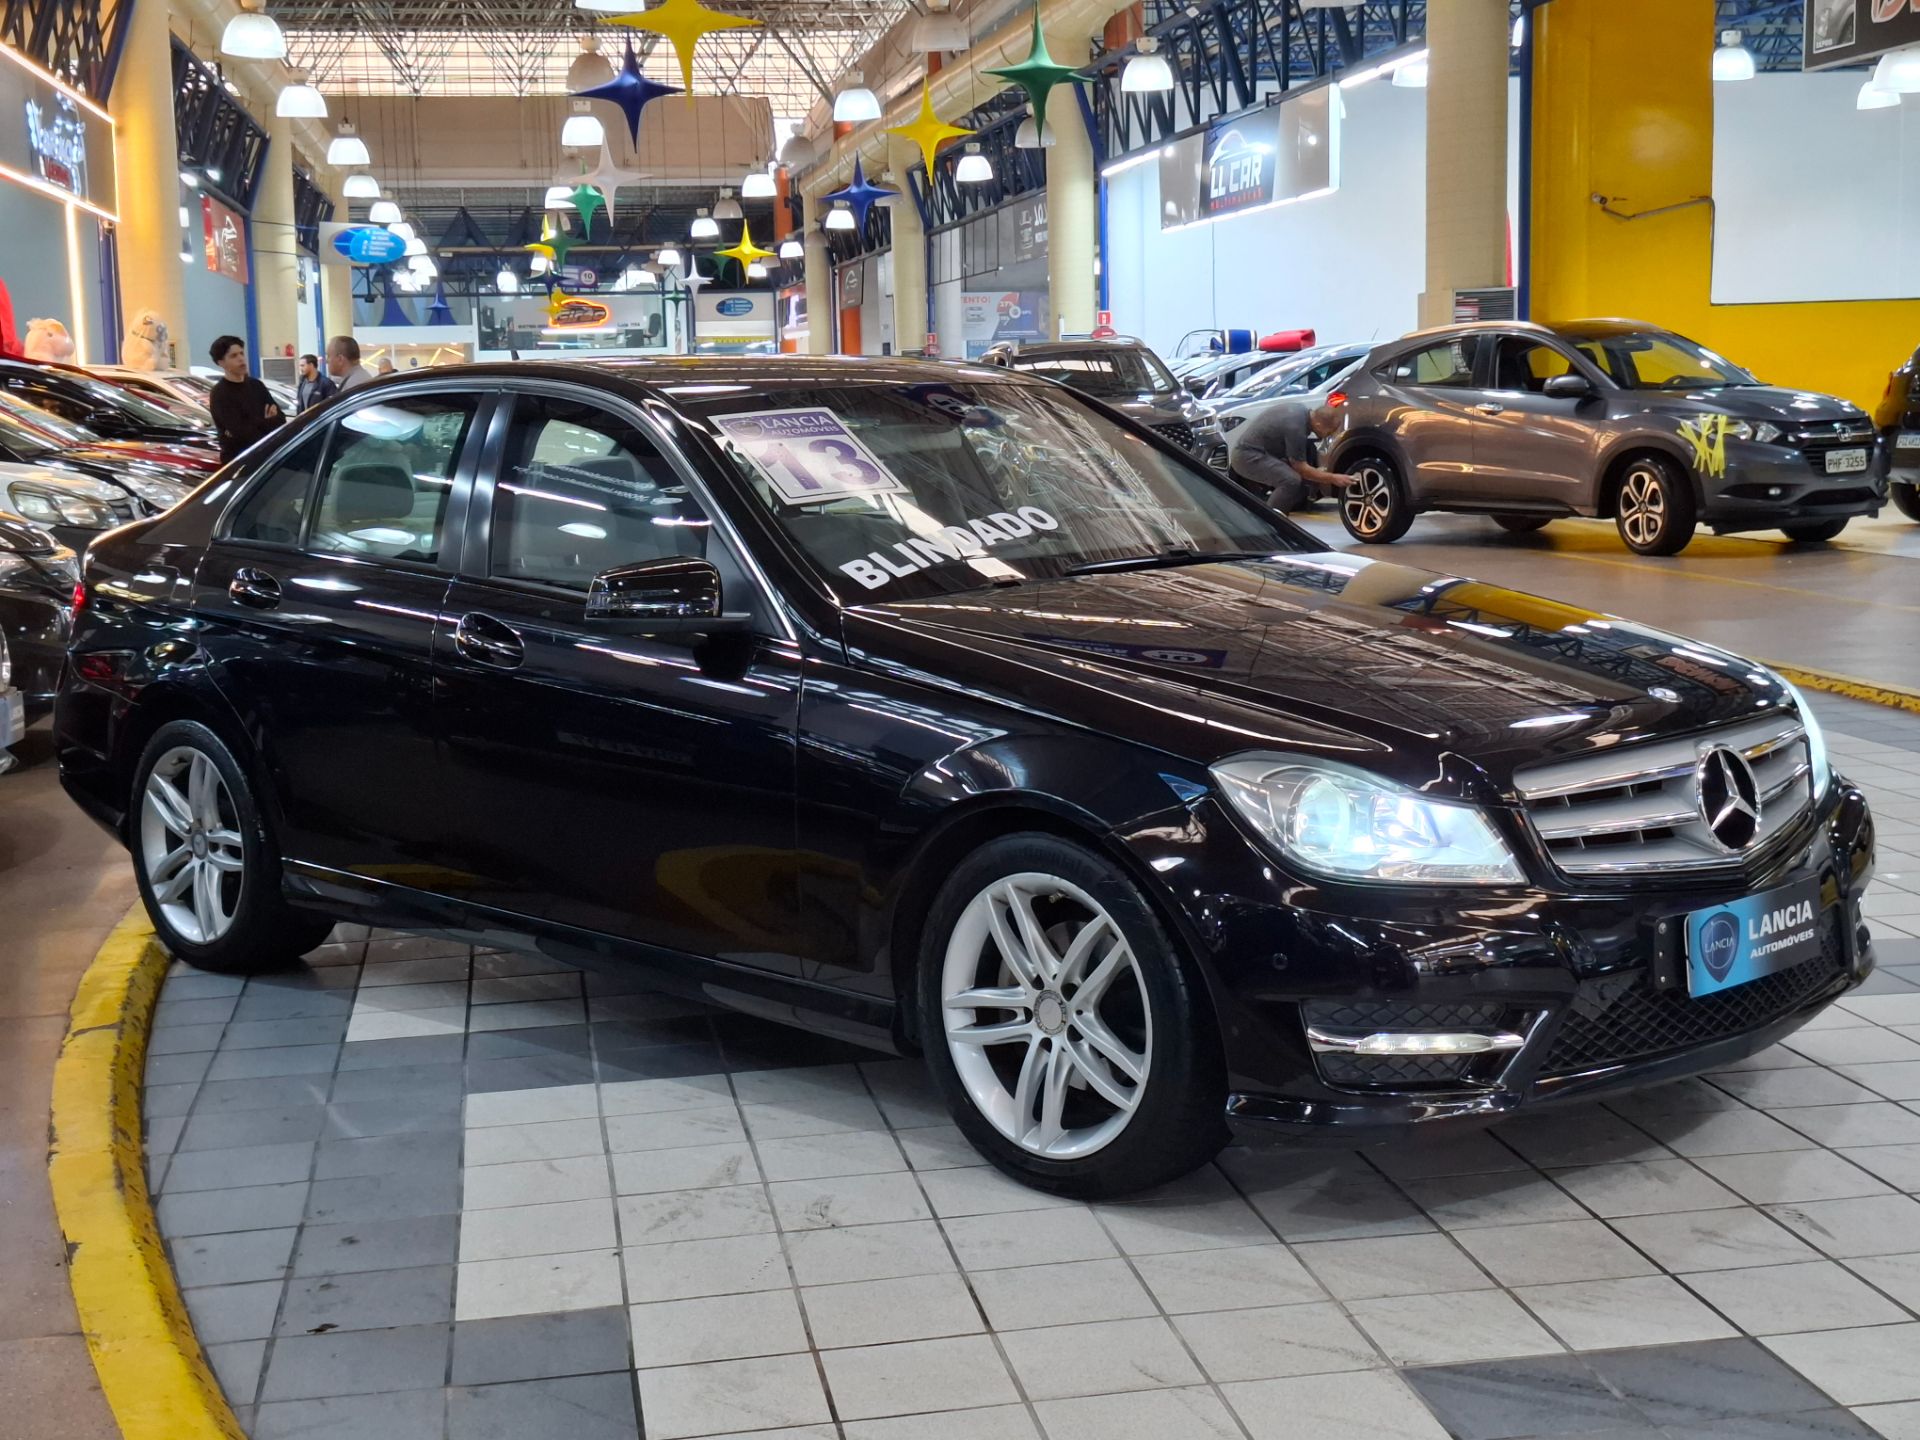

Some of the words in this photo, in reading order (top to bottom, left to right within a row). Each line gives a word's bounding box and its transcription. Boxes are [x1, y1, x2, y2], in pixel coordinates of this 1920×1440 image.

[1210, 165, 1226, 198] LL
[1230, 154, 1263, 192] CAR
[760, 415, 834, 429] LANCIA
[771, 425, 841, 436] AUTOMÓVEIS
[759, 439, 881, 490] 13
[839, 506, 1059, 590] BLINDADO
[1748, 899, 1813, 940] LANCIA
[1704, 936, 1735, 953] LANCIA
[1751, 928, 1815, 960] AUTOMÓVEIS
